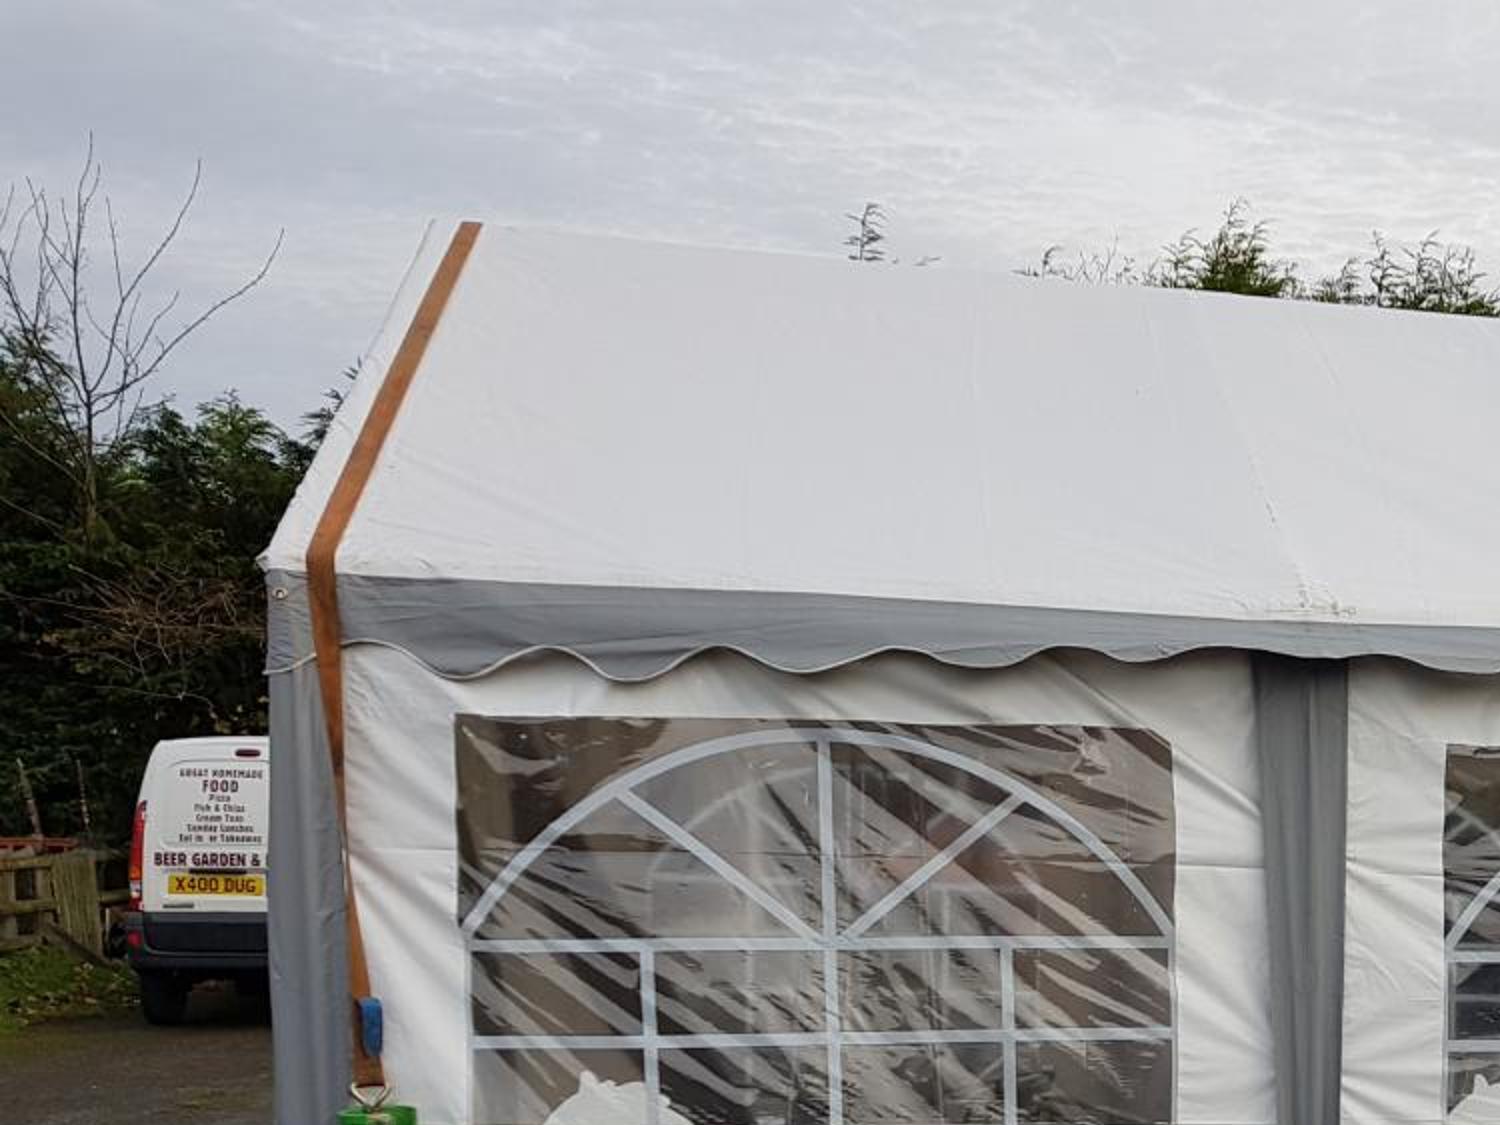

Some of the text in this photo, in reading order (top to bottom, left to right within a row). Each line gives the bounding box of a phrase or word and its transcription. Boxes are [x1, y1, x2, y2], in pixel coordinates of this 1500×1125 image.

[202, 780, 239, 793] FOOD
[154, 852, 187, 867] BEER
[191, 853, 247, 867] GARDEN
[252, 854, 261, 867] &
[175, 877, 257, 893] X400 DUG
